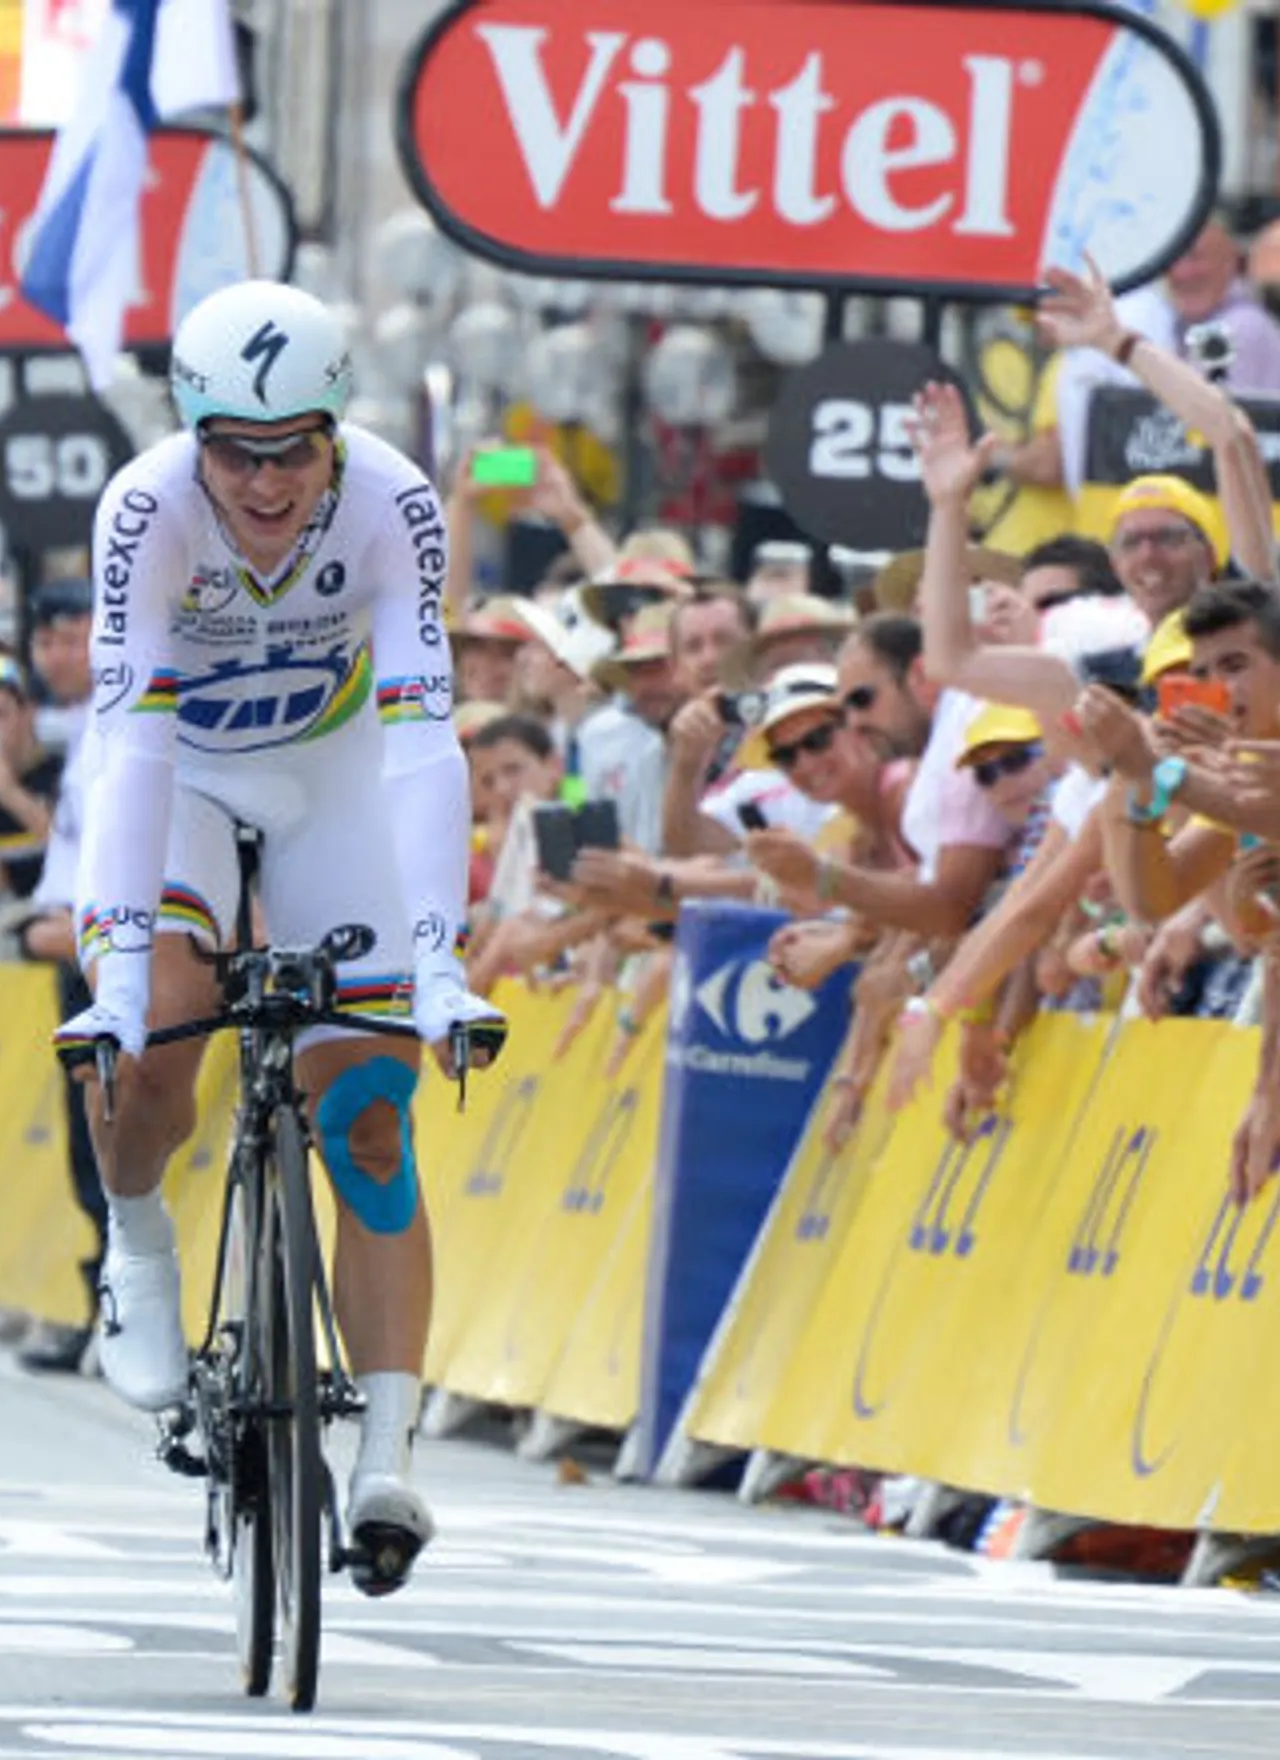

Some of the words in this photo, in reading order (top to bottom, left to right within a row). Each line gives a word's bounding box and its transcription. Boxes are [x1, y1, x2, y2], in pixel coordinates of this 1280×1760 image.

[474, 22, 1017, 238] Vittel
[5, 435, 106, 499] 50
[809, 398, 924, 484] 25
[98, 489, 158, 645] latexco
[395, 484, 448, 647] latexco
